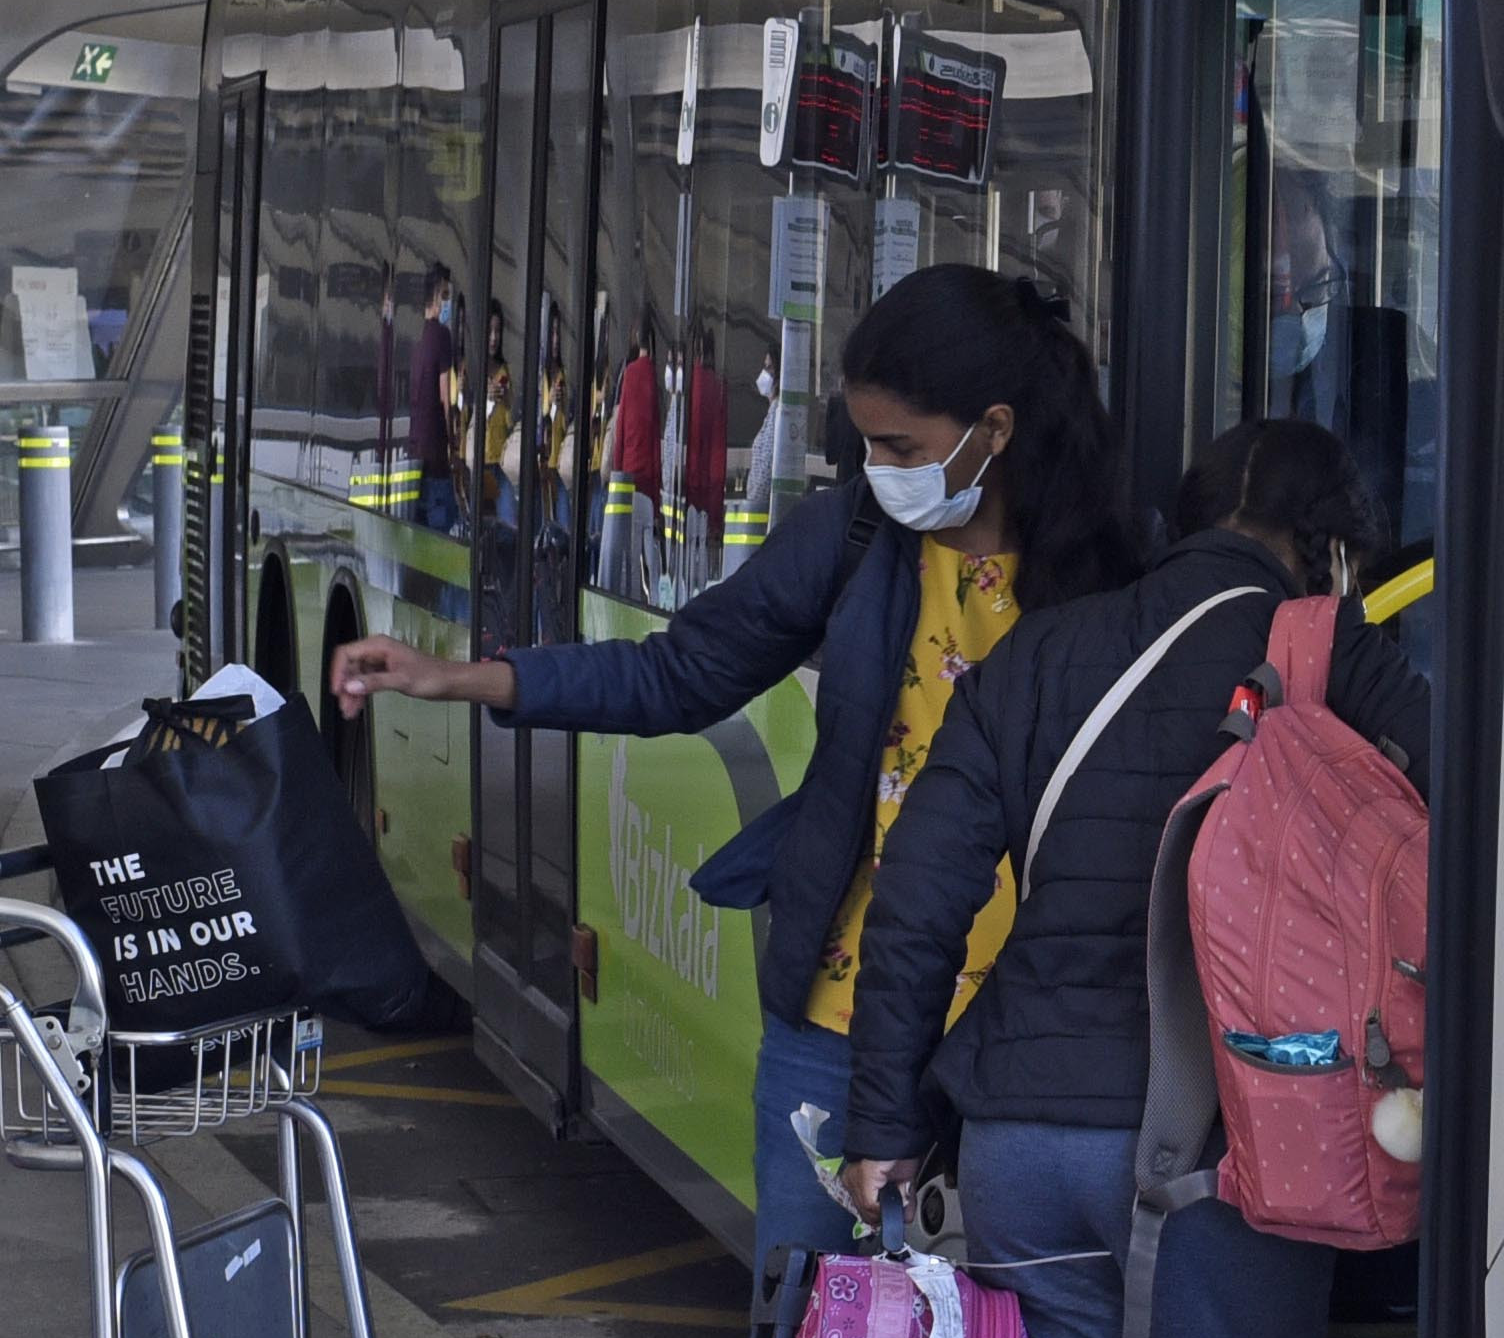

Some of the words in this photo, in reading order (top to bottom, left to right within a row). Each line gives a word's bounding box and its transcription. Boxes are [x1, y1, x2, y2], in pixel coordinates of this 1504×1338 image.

[90, 852, 146, 888] THE
[100, 867, 242, 925] FUTURE
[113, 933, 138, 962] IS
[148, 926, 182, 956] IN
[189, 910, 257, 948] OUR
[118, 952, 262, 1005] HANDS.
